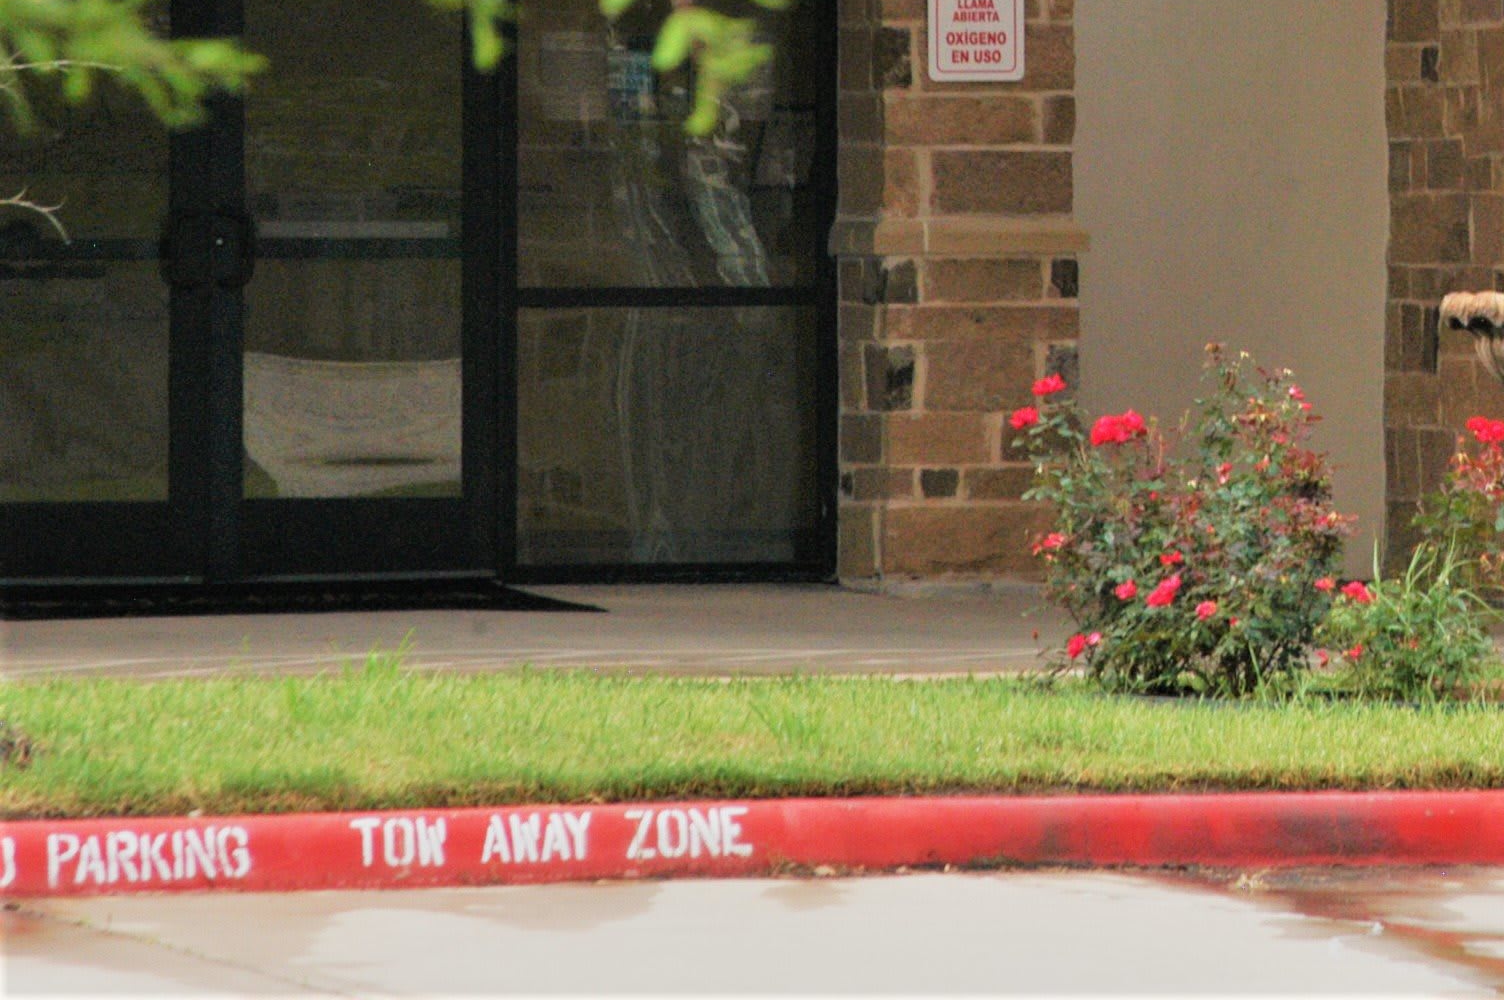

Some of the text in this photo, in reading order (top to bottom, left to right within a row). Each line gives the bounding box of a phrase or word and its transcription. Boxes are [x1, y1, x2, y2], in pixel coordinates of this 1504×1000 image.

[953, 11, 1000, 22] ABIERTA
[951, 50, 1002, 64] EN USO
[47, 825, 252, 888] PARKING
[350, 815, 446, 867] TOW
[481, 811, 592, 864] AWAY
[624, 806, 753, 859] ZONE
